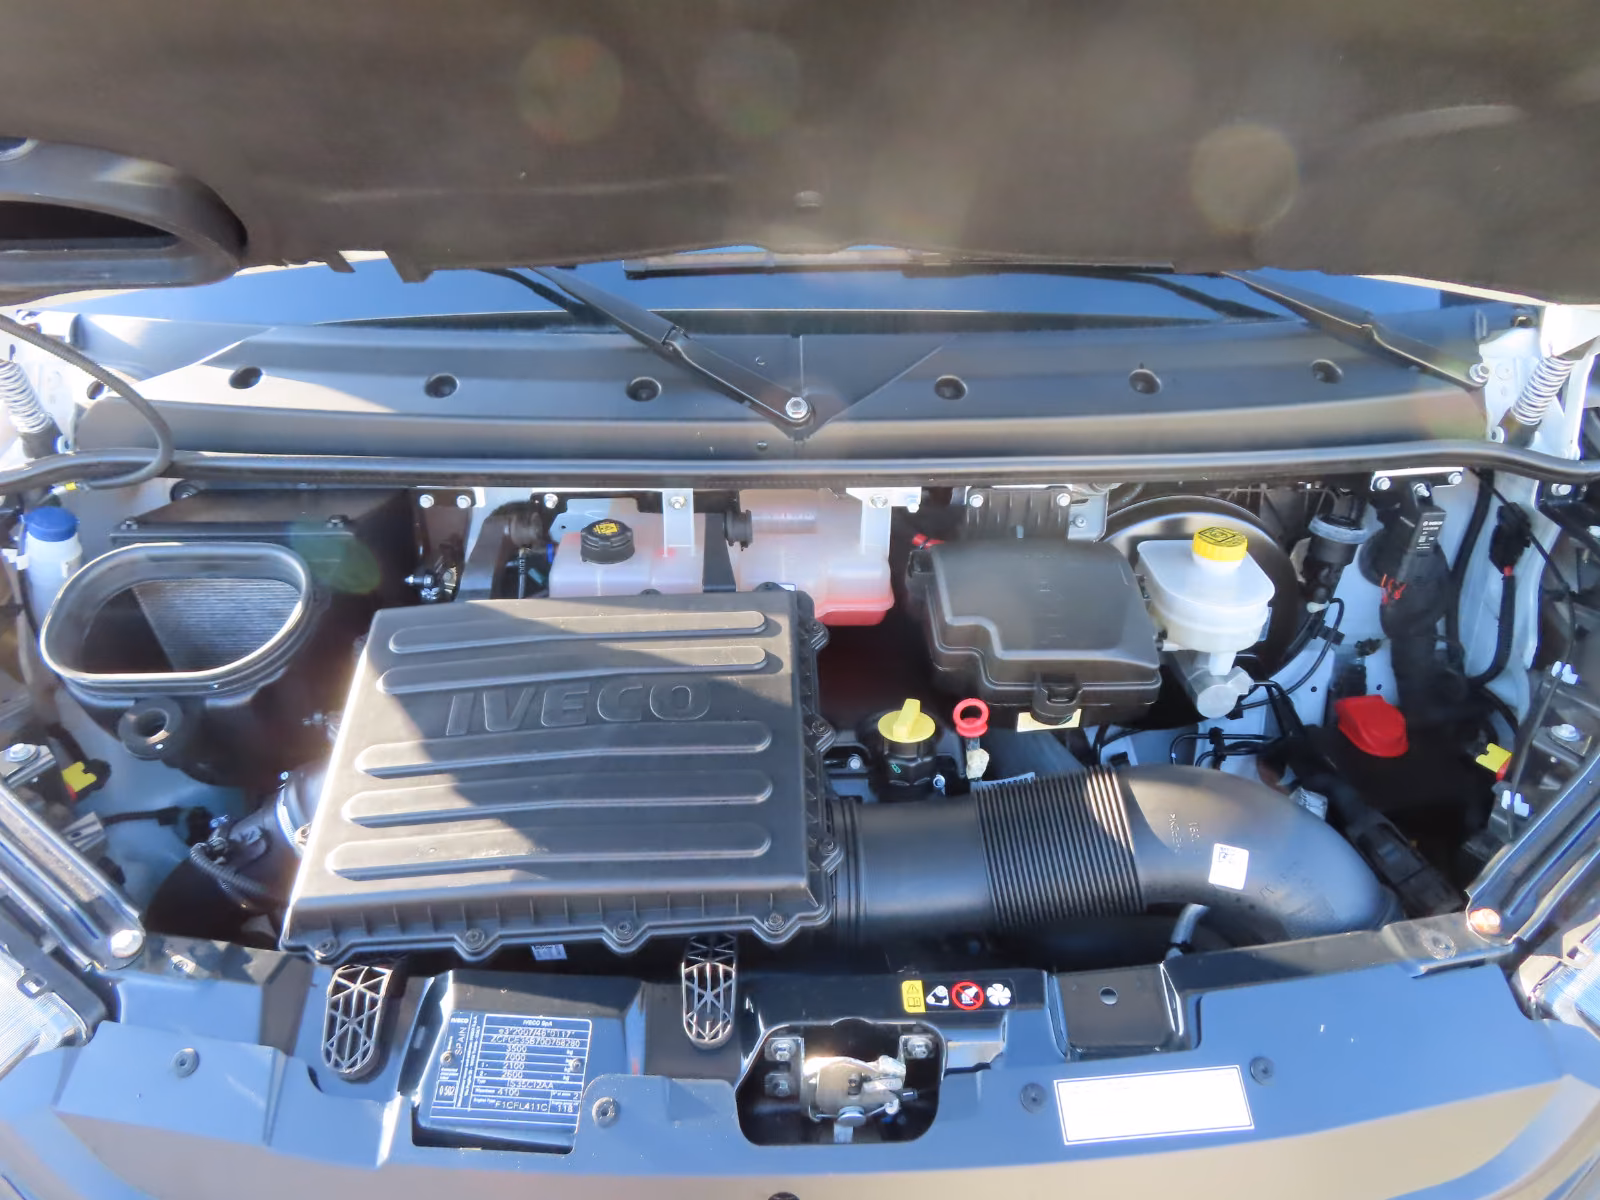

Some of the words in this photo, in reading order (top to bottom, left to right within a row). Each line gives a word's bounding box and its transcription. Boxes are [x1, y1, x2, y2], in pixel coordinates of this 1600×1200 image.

[445, 677, 711, 736] IVECO
[454, 1026, 467, 1056] SPAIN
[506, 1044, 528, 1053] 3500
[504, 1052, 526, 1061] 7000
[503, 1061, 525, 1070] 2100
[502, 1070, 523, 1079] 2600
[498, 1087, 520, 1096] 4100
[572, 1092, 579, 1100] 2
